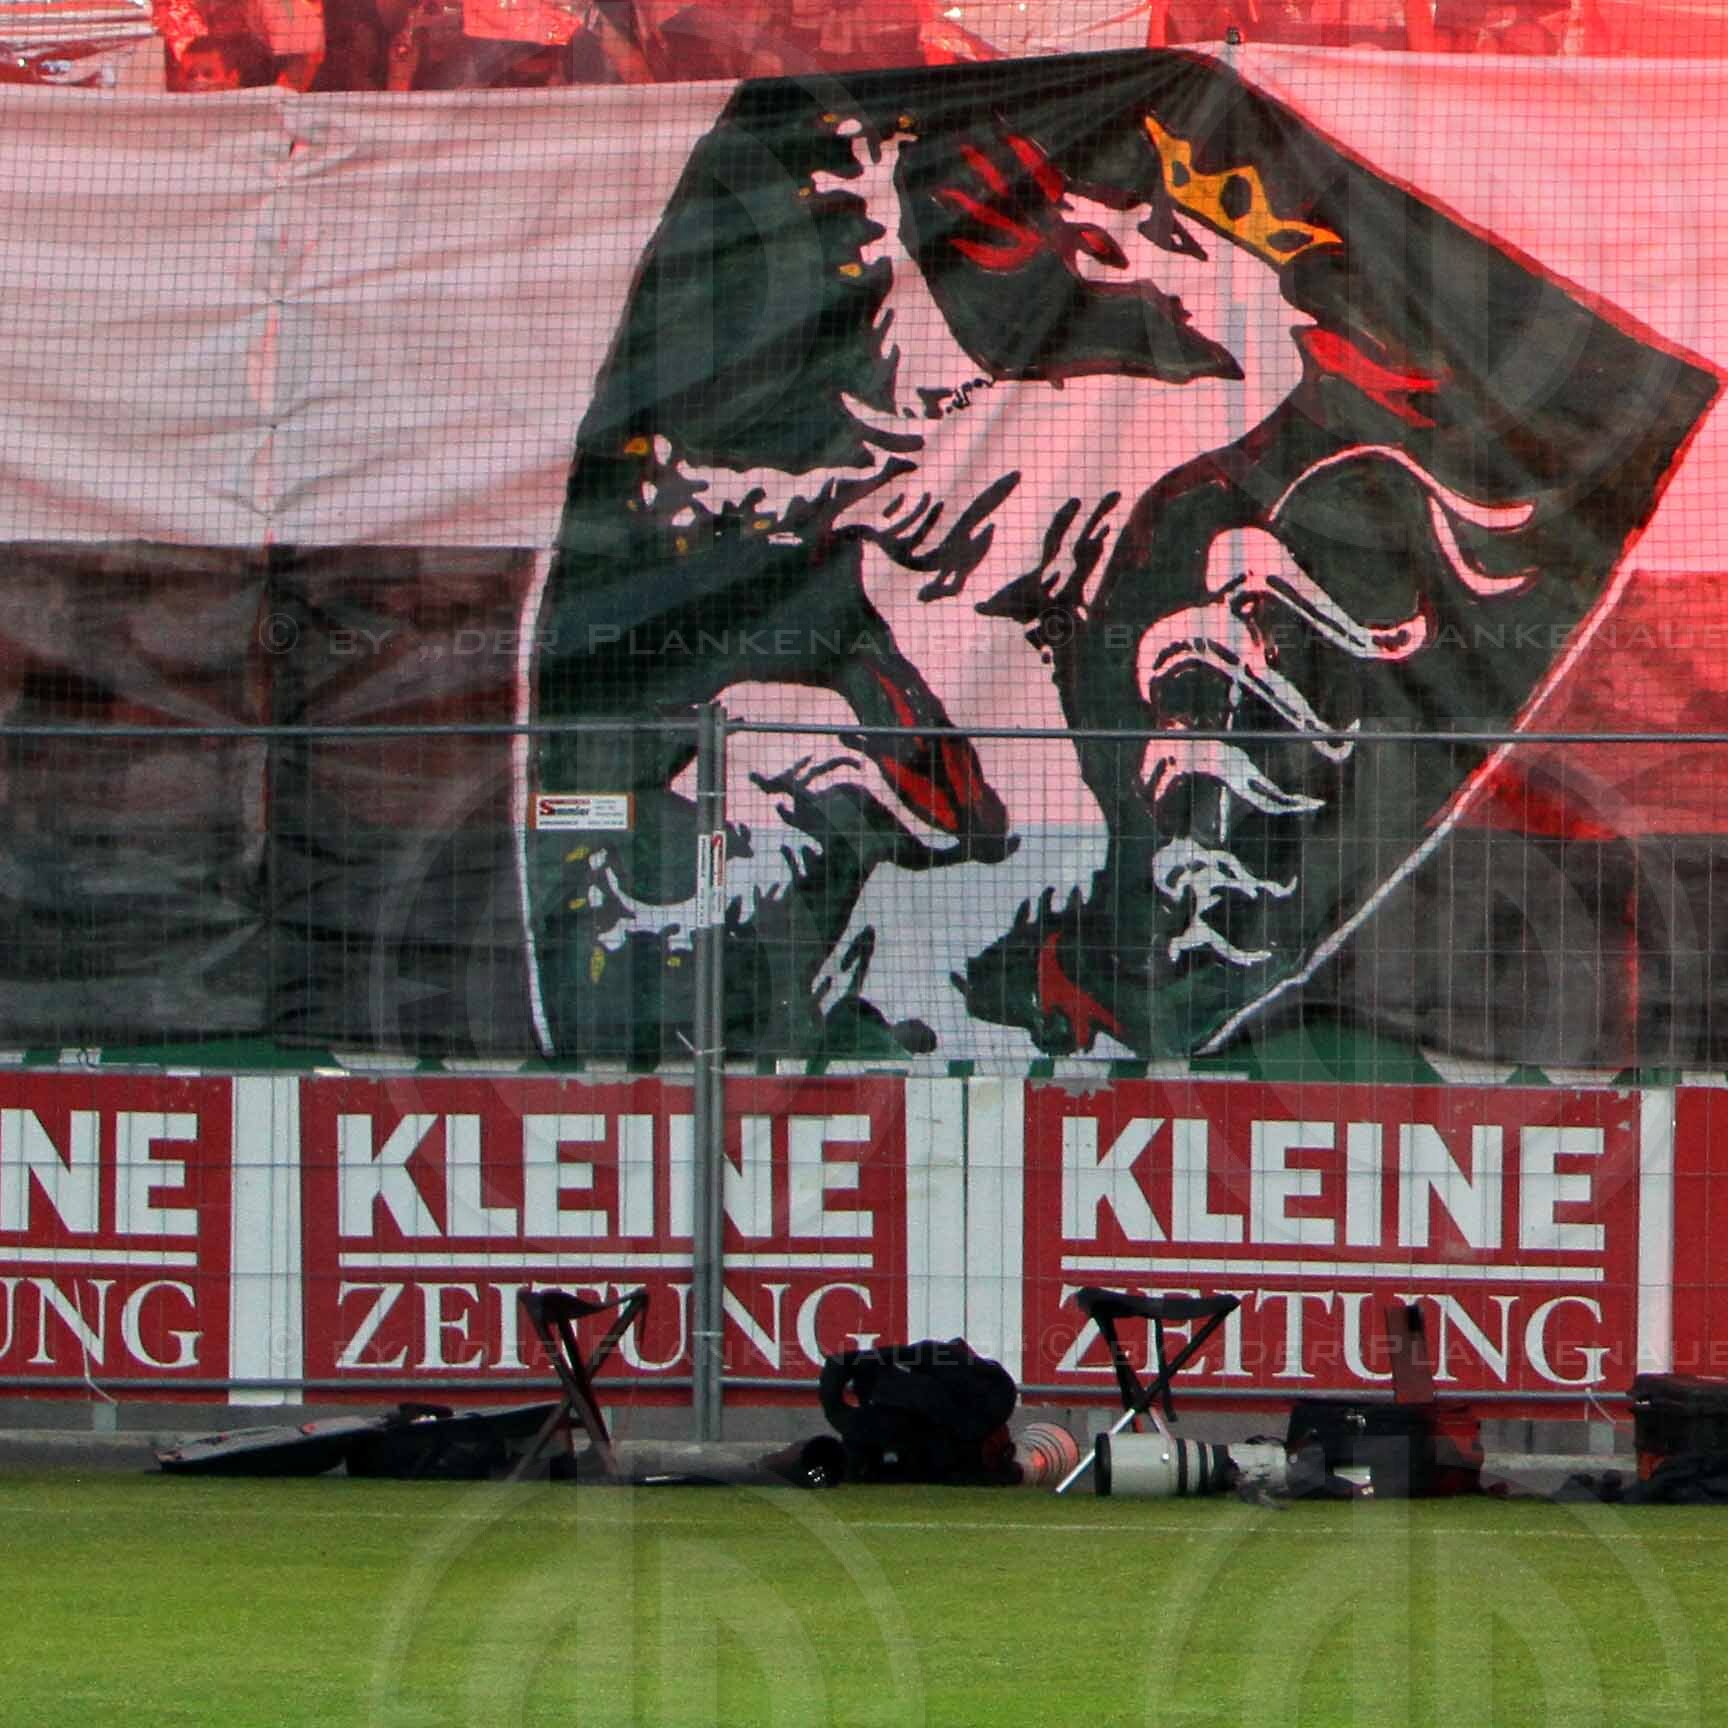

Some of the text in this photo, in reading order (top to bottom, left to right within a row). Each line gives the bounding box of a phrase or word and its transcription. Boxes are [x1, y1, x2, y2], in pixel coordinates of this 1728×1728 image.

[337, 1113, 875, 1239] KLEINE
[1061, 1116, 1606, 1251] KLEINE
[1056, 1282, 1611, 1388] ZEITUNG
